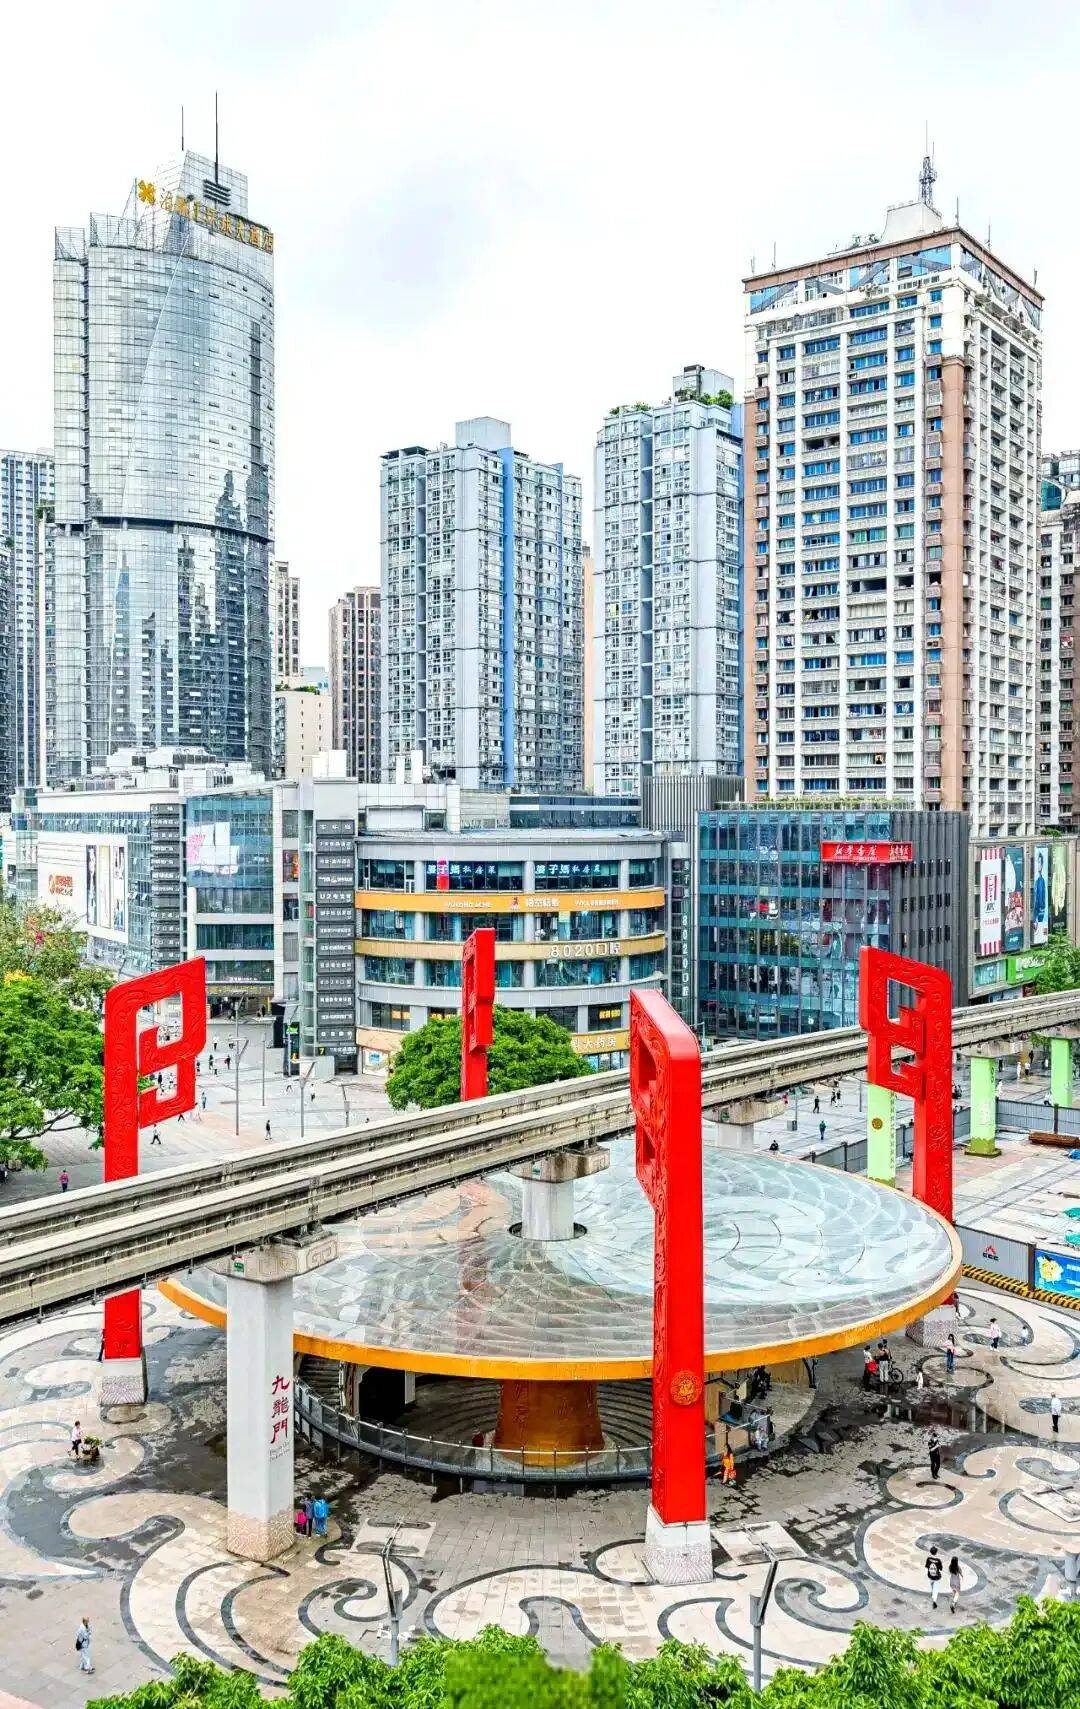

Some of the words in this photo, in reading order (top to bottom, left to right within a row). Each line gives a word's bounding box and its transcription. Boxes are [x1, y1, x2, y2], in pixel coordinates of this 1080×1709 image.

[551, 942, 620, 957] 8020口腔
[270, 1375, 290, 1443] 九龍門
